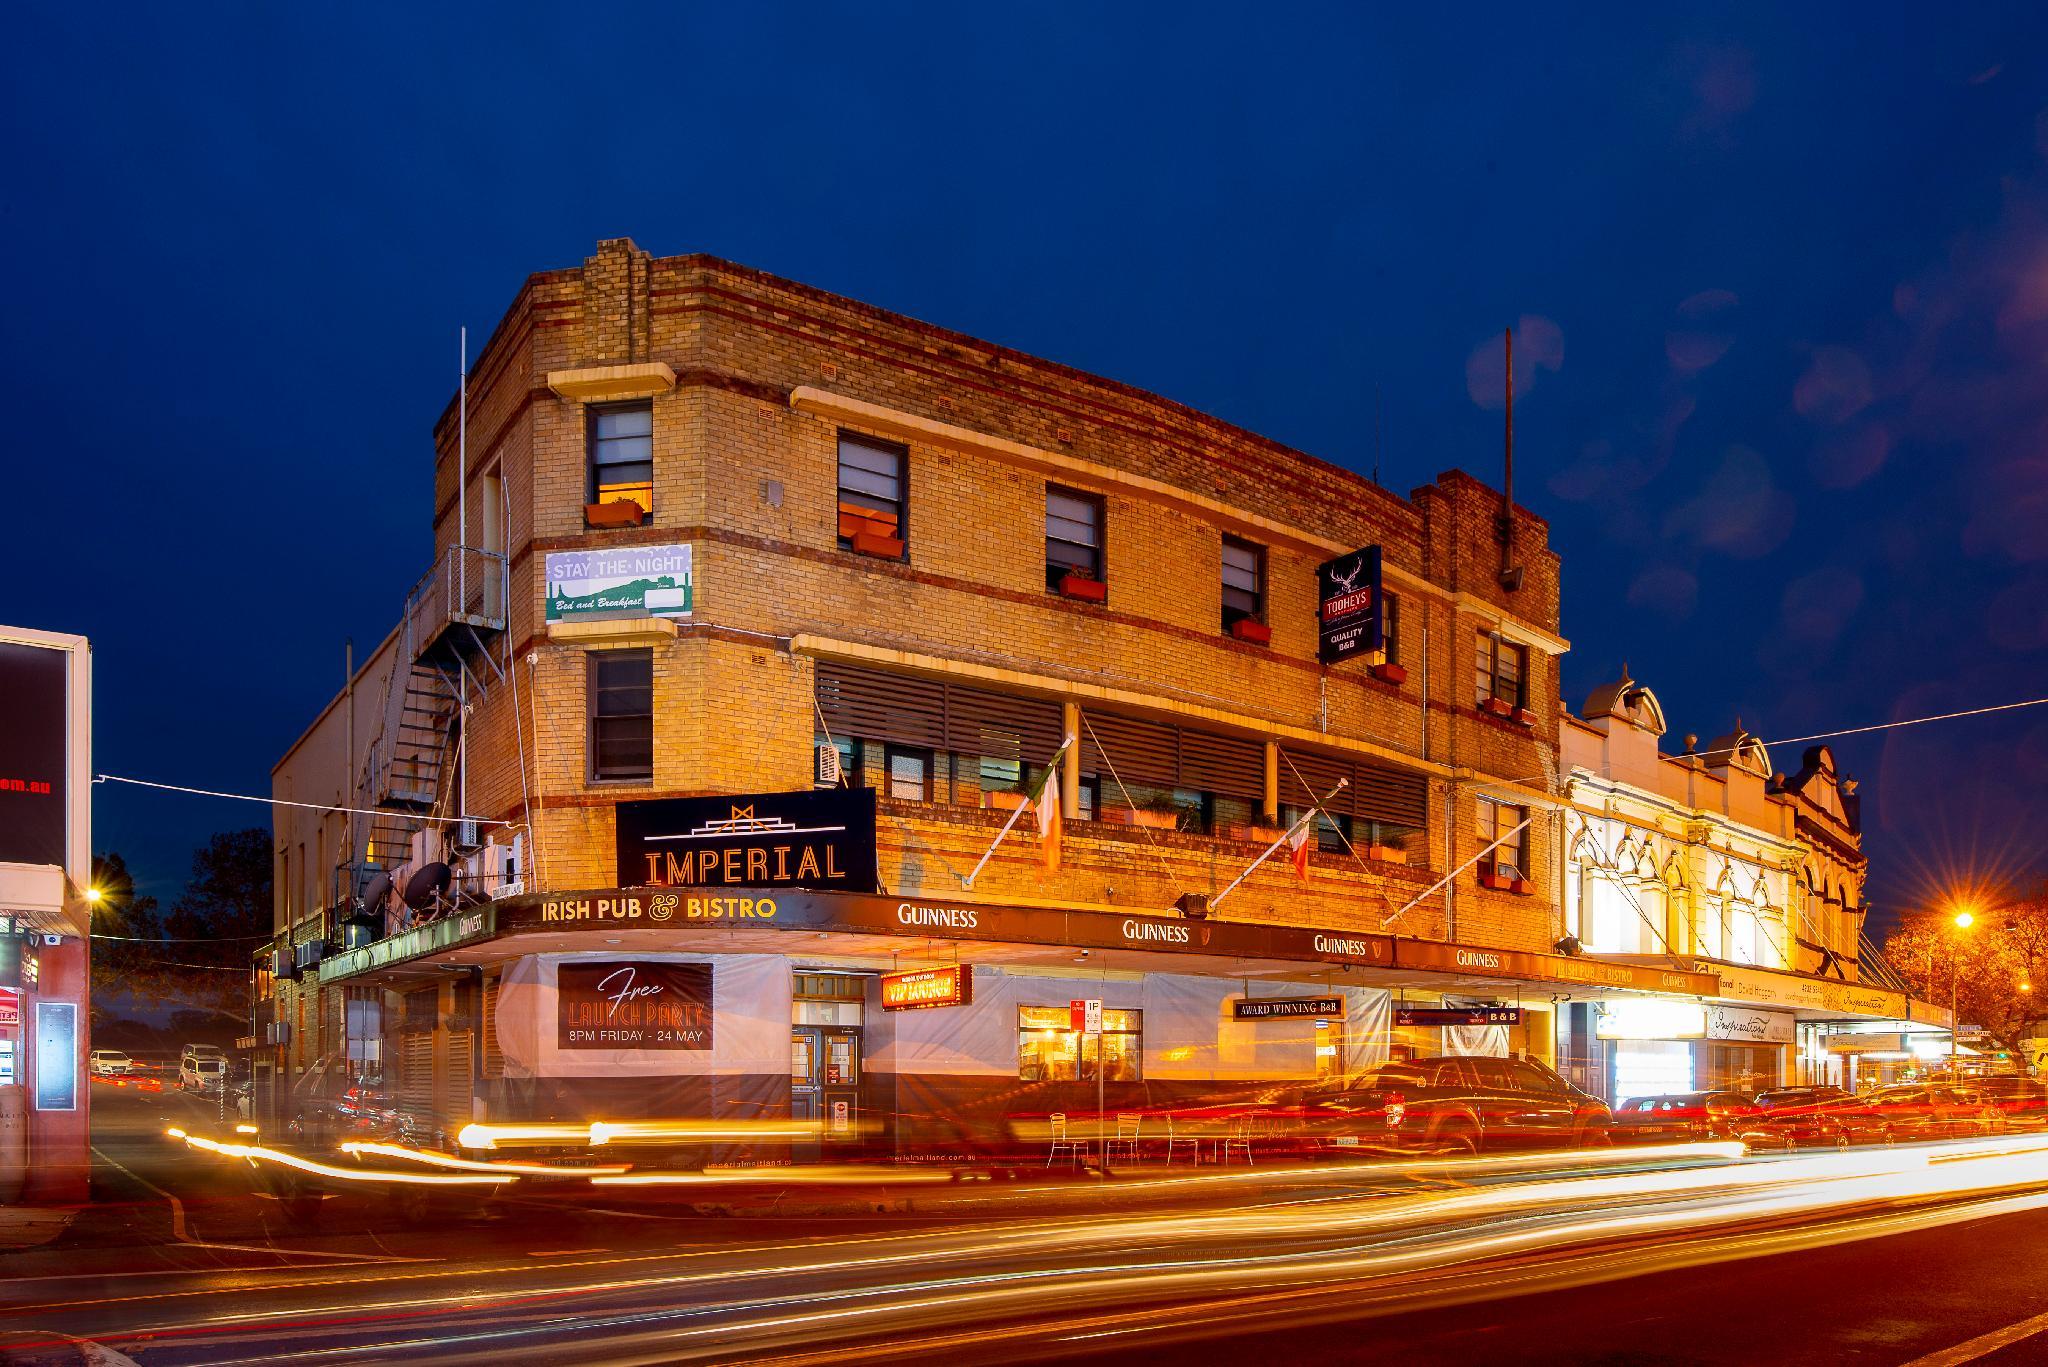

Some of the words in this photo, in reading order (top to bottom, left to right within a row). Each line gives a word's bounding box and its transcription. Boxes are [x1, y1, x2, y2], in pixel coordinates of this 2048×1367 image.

[553, 562, 591, 579] STAY
[597, 559, 628, 575] THE
[635, 556, 684, 573] NIGHT
[555, 600, 574, 611] Bed
[576, 600, 595, 609] and
[597, 597, 643, 609] Breakfast
[1326, 591, 1367, 615] TOOHEYS
[1331, 627, 1363, 643] QUALITY
[1338, 640, 1355, 651] B&B
[645, 844, 846, 886] IMPERIAL
[542, 900, 590, 921] IRISH
[597, 898, 641, 919] PUB
[648, 894, 679, 921] &
[687, 898, 777, 919] BISTRO
[897, 903, 978, 927] GUINNESS
[459, 914, 482, 936] GUINNESS
[1122, 919, 1190, 943] GUINNESS
[1314, 934, 1366, 955] GUINNESS
[1456, 949, 1499, 968] GUINNESS
[1557, 962, 1578, 977] IRISH
[1579, 964, 1595, 978] PUB
[1607, 968, 1633, 983] BISTRO
[1662, 972, 1686, 988] GUINNESS
[597, 967, 664, 1018] Free
[568, 1001, 641, 1026] LAUNCH
[646, 1001, 705, 1027] PARTY
[1241, 1004, 1270, 1015] AWARD
[1272, 1001, 1317, 1014] WINNING
[1320, 1002, 1338, 1013] B&B
[1490, 1012, 1498, 1021] B
[1499, 1012, 1507, 1021] &
[1509, 1012, 1517, 1021] B
[569, 1030, 595, 1041] 8PM
[600, 1030, 644, 1041] FRIDAY
[657, 1030, 672, 1041] 24
[676, 1030, 703, 1041] MAY
